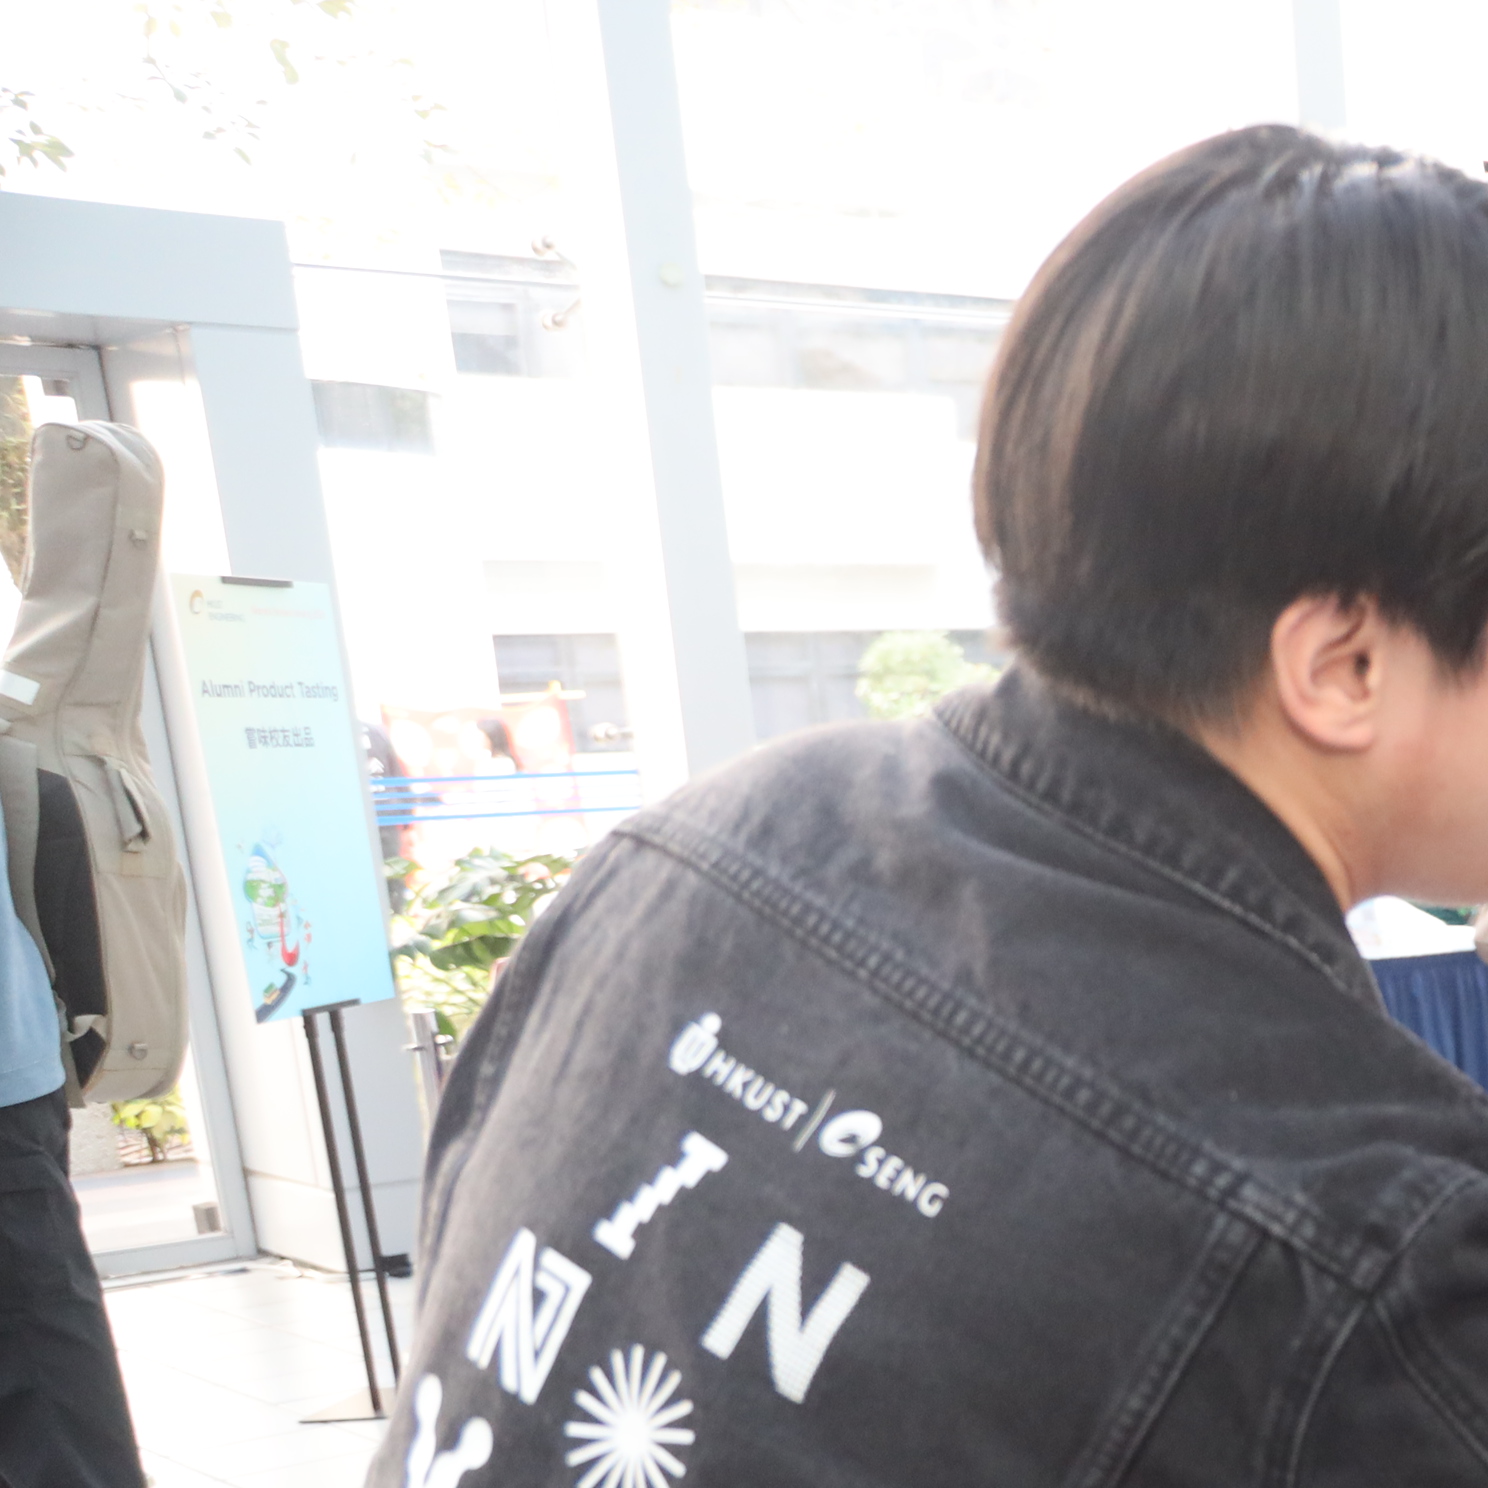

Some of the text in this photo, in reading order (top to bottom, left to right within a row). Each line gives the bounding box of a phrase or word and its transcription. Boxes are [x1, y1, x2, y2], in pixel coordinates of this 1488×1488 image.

[201, 679, 339, 702] Alumni Product Tasting
[702, 1047, 950, 1219] HKUST SENG
